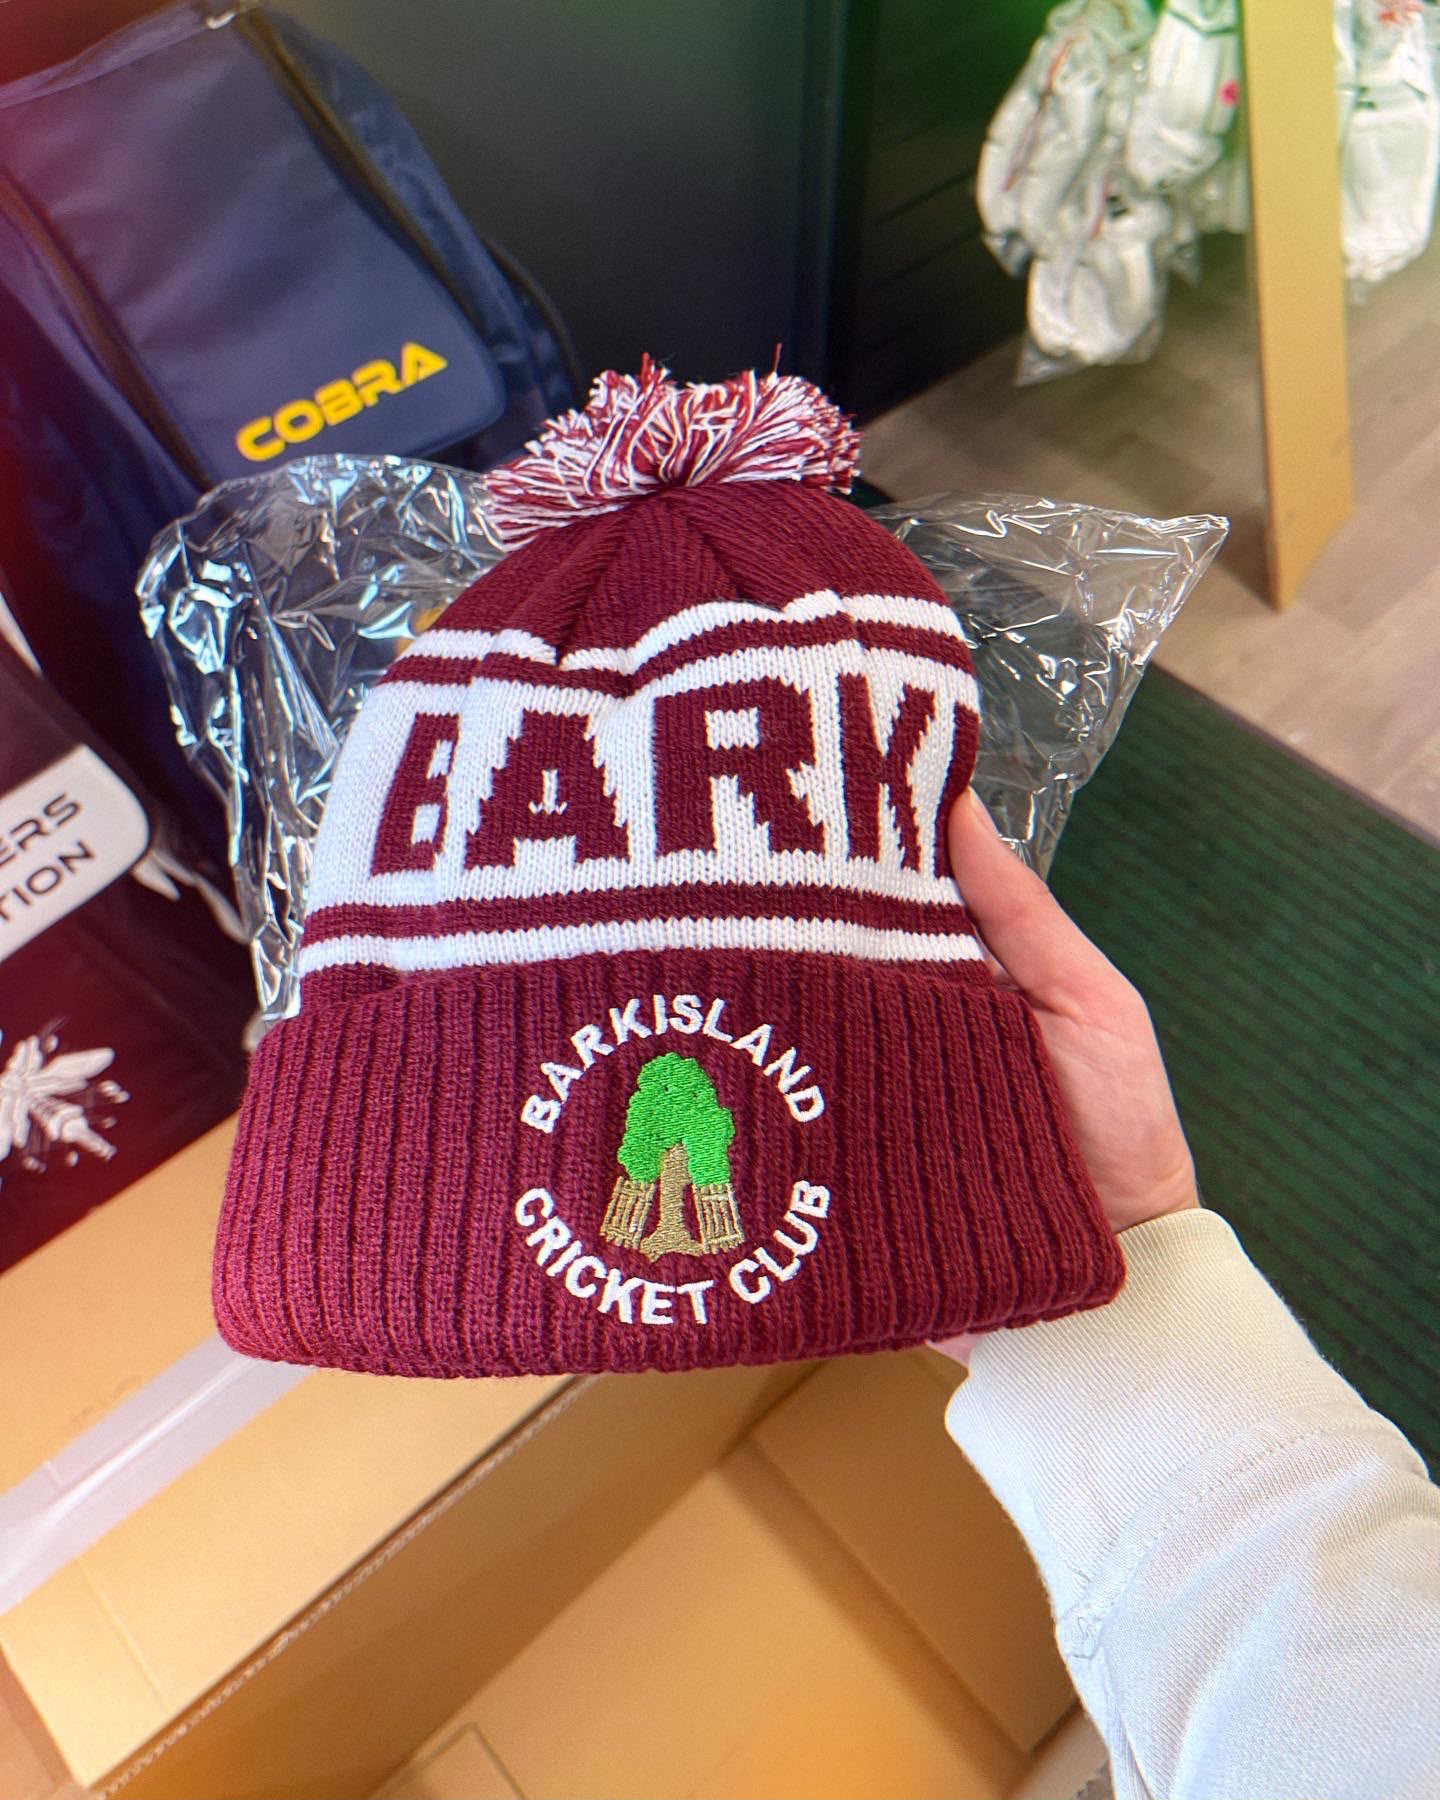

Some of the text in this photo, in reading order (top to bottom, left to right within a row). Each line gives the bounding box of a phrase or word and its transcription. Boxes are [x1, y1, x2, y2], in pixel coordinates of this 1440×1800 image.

[236, 341, 448, 462] COBRA
[521, 994, 825, 1133] BARKISLAND
[515, 1180, 830, 1324] CRICKET CLUB
